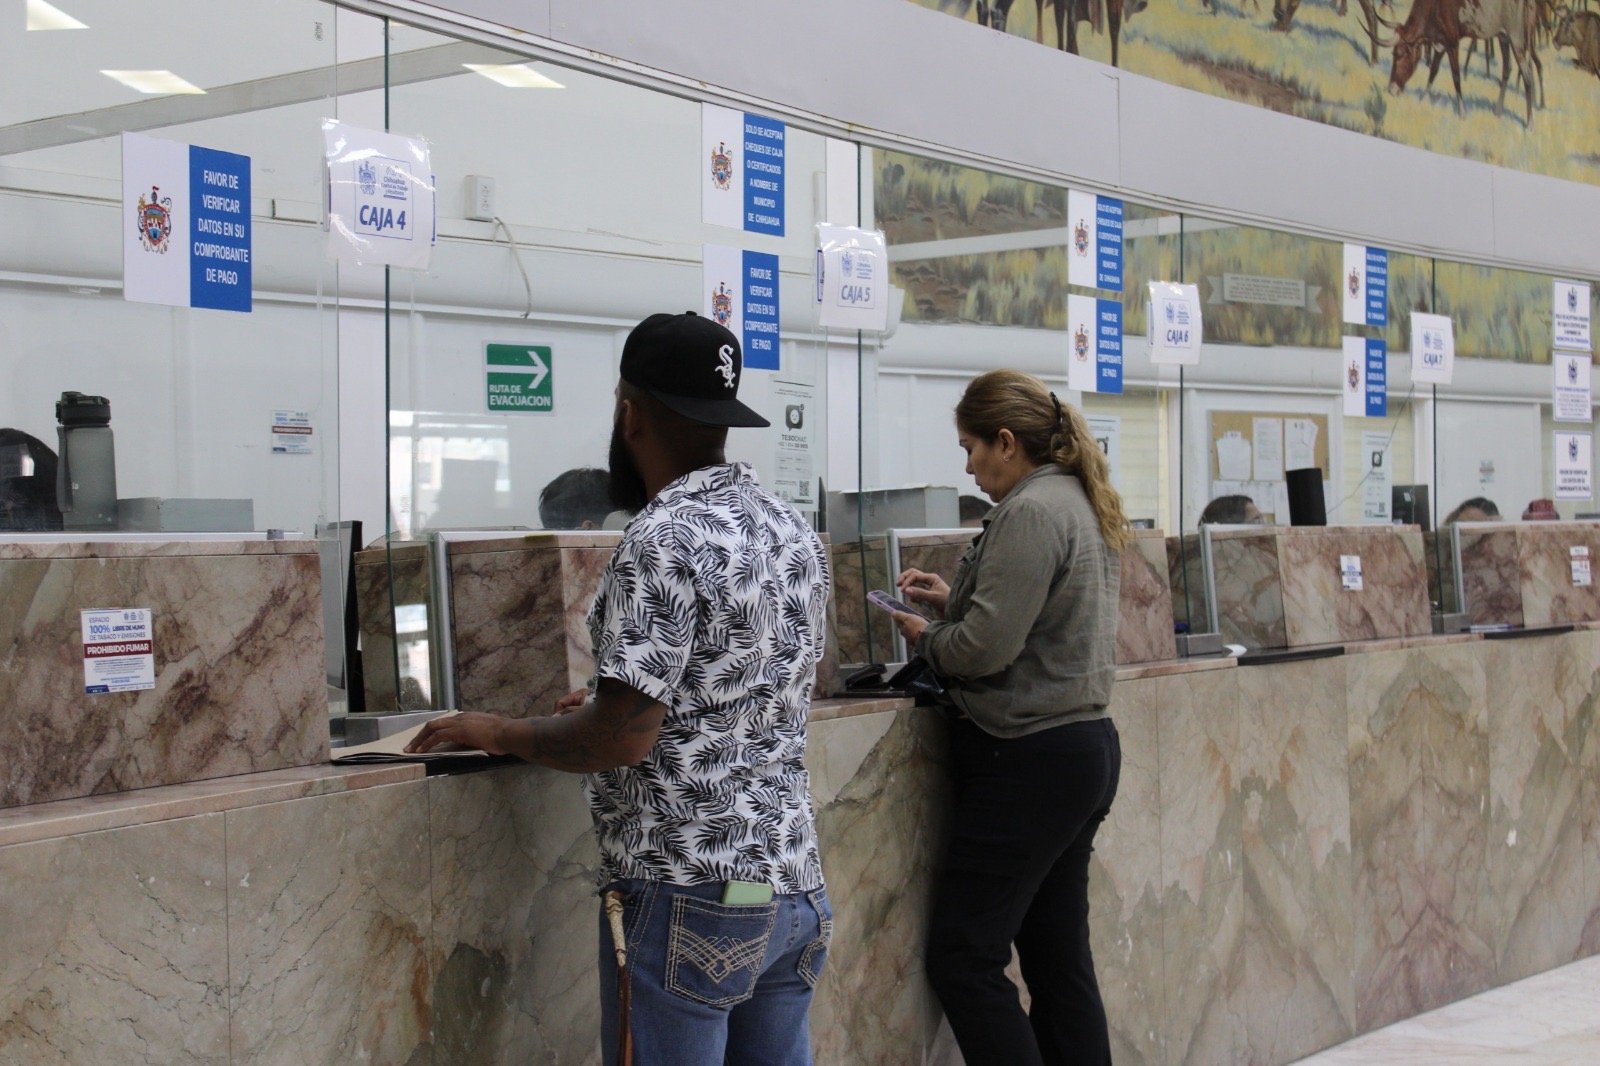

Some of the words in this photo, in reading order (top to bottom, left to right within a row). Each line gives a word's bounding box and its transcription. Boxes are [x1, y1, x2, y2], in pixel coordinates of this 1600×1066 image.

[746, 124, 757, 134] SOLO
[758, 127, 763, 136] SE
[764, 128, 783, 140] ACEPTAN
[745, 141, 764, 154] CHEQUES
[765, 145, 771, 155] DE
[772, 147, 783, 157] CAJA
[747, 160, 750, 168] O
[752, 160, 781, 175] CERTIFICADOS
[204, 170, 227, 187] FAVOR
[228, 176, 238, 189] DE
[750, 178, 753, 186] A
[754, 179, 771, 190] NOMBRE
[772, 182, 778, 191] DE
[203, 194, 240, 213] VERIFICAR
[754, 196, 775, 208] MUNICIPIO
[360, 205, 393, 231] CAJA
[397, 210, 406, 230] 4
[748, 213, 754, 222] DE
[756, 214, 780, 226] CHIHUAHUA
[198, 218, 222, 235] DATOS
[224, 222, 233, 236] EN
[235, 224, 244, 238] SU
[194, 242, 248, 262] COMPROBANTE
[206, 268, 216, 282] DE
[218, 270, 237, 285] PAGO
[750, 267, 764, 278] FAVOR
[764, 269, 772, 280] DE
[750, 285, 772, 297] VERIFICAR
[842, 285, 862, 304] CAJA
[864, 287, 870, 302] 5
[747, 303, 761, 314] DATOS
[762, 304, 768, 314] EN
[769, 305, 775, 316] SU
[745, 320, 778, 334] COMPROBANTE
[1167, 330, 1182, 344] CAJA
[1184, 330, 1189, 342] 6
[752, 339, 758, 349] DE
[759, 339, 771, 350] PAGO
[490, 385, 510, 393] RUTA
[511, 385, 521, 393] DE
[490, 395, 551, 406] EVACUACION
[90, 625, 110, 633] 100%
[87, 645, 125, 654] PROHIBIDO
[126, 643, 149, 652] FUMAR
